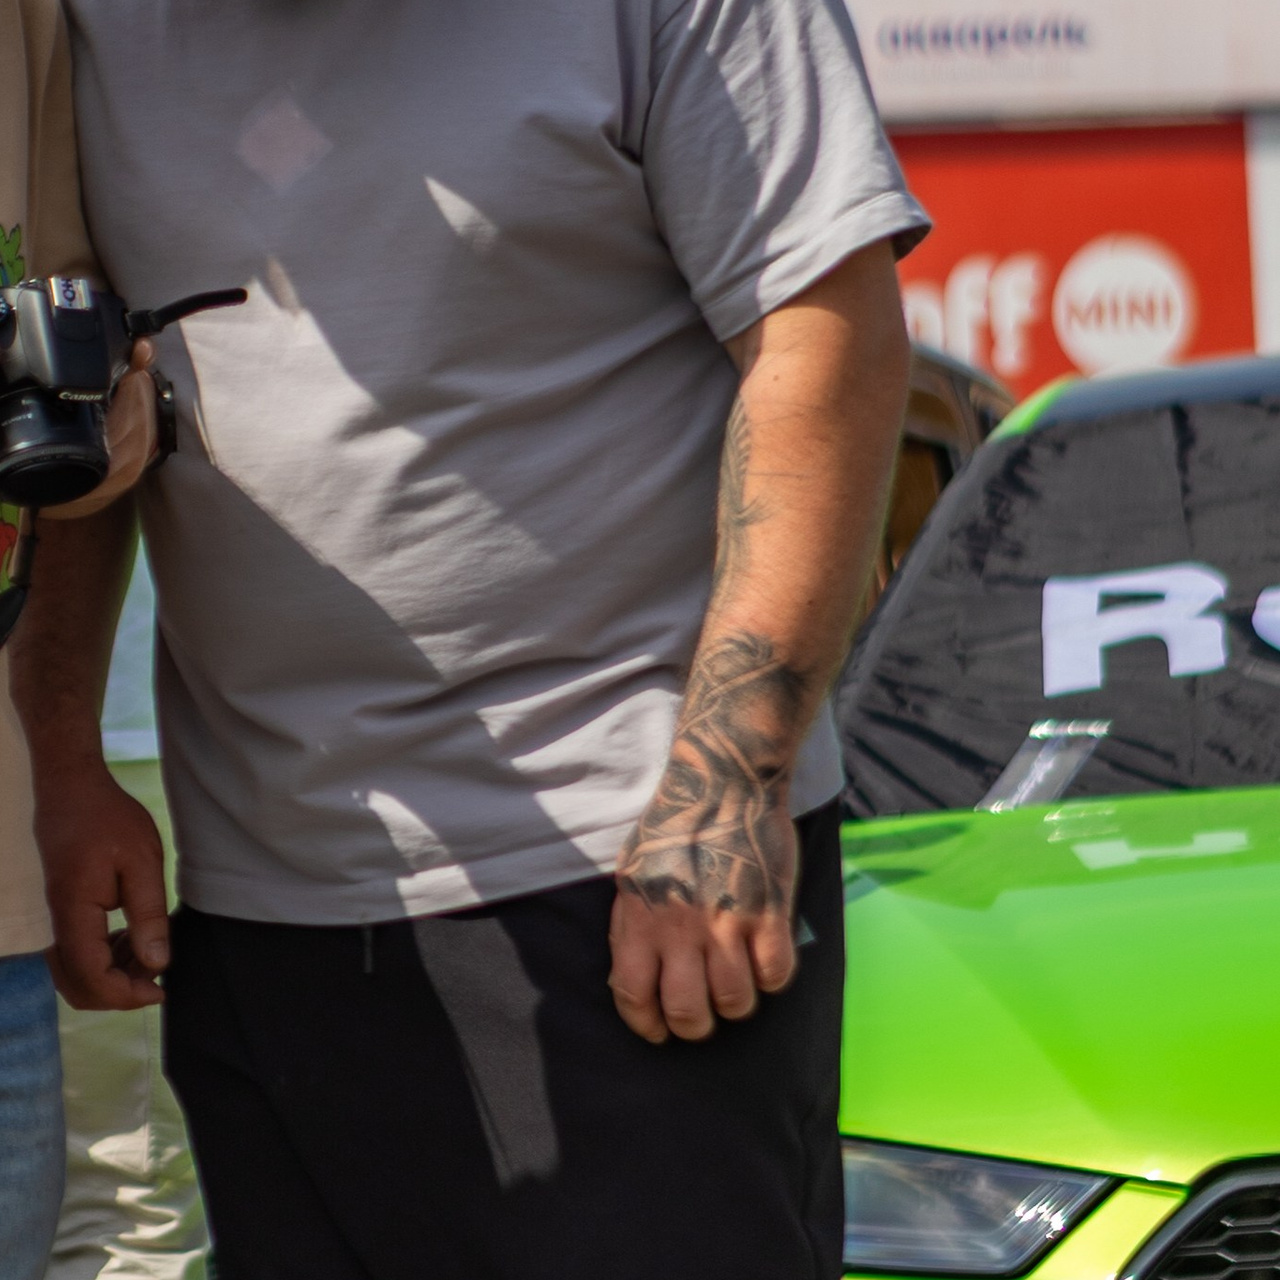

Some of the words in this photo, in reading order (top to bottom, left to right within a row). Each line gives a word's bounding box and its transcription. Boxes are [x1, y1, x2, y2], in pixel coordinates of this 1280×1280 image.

[1065, 290, 1177, 332] MINI
[58, 391, 103, 401] Canon
[1042, 561, 1280, 698] R
